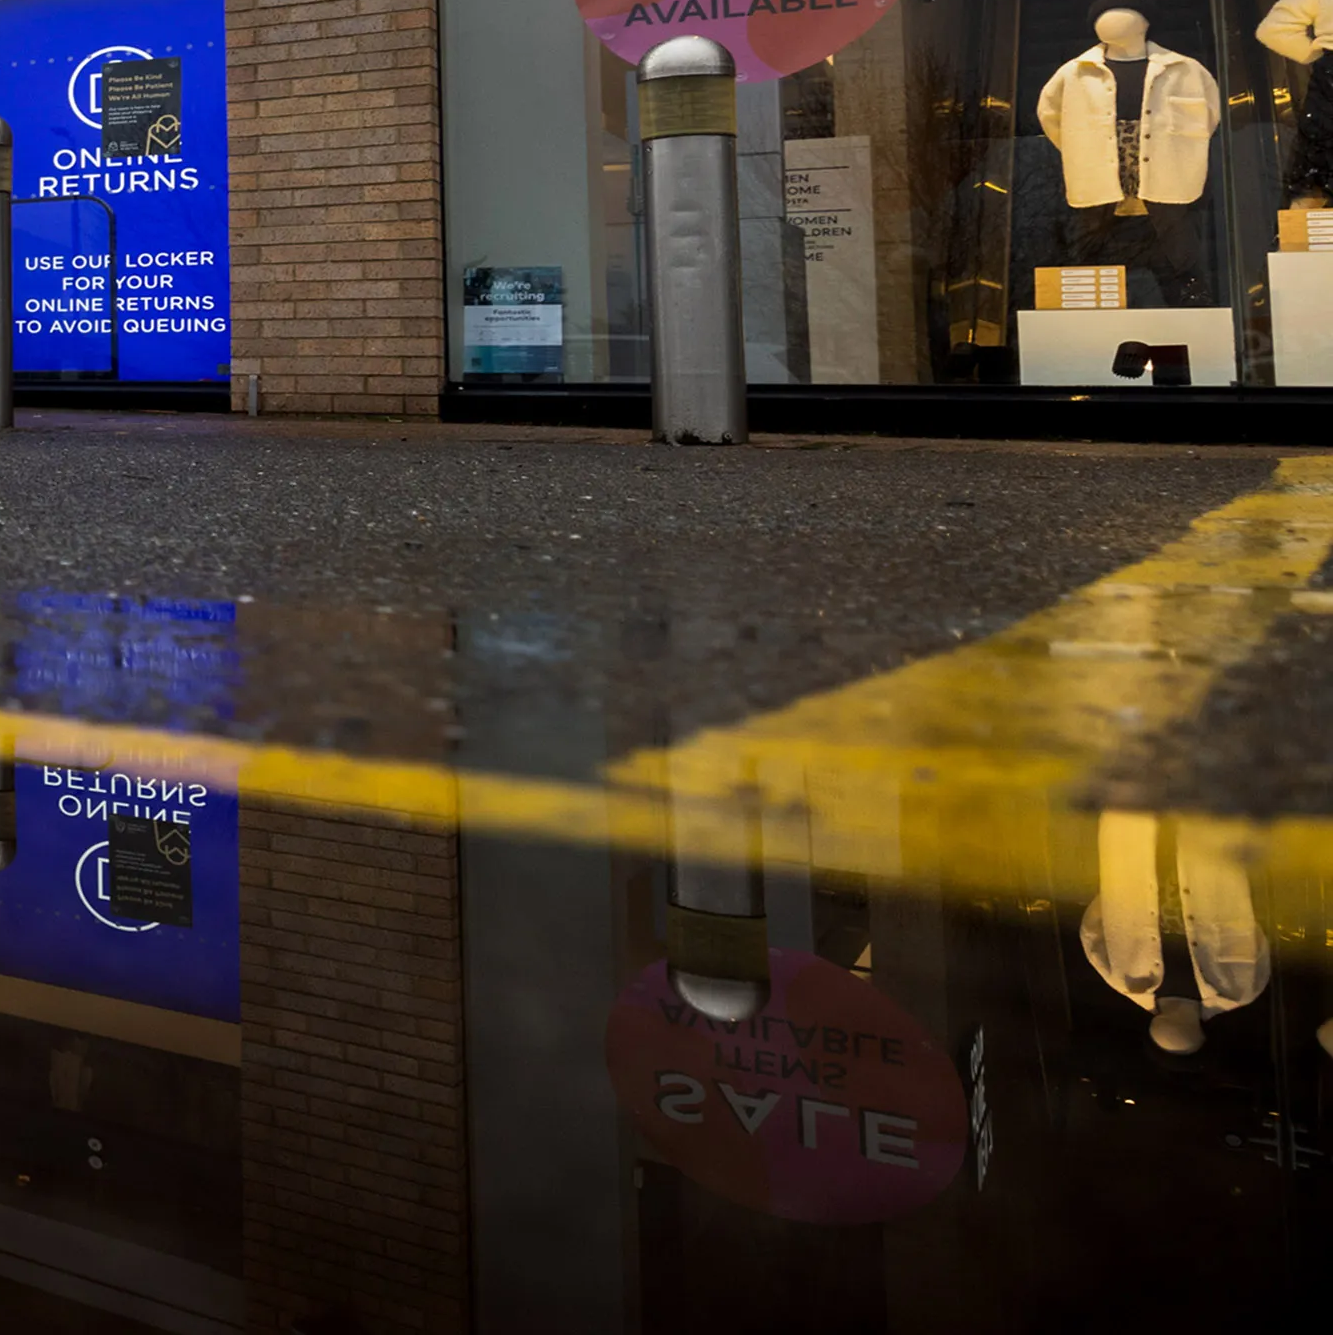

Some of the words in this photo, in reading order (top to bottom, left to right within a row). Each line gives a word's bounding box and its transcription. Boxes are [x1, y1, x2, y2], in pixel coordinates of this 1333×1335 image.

[108, 76, 132, 84] Please
[134, 74, 144, 82] Be
[145, 73, 163, 81] Kind
[108, 85, 133, 93] Please
[134, 83, 144, 91] Be
[145, 82, 174, 90] Patient
[39, 167, 199, 197] RETURNS
[784, 174, 810, 184] EN
[786, 185, 821, 195] OME
[25, 256, 64, 270] USE
[126, 251, 214, 267] LOCKER
[62, 276, 105, 290] FOR
[116, 274, 173, 289] YOUR
[493, 281, 532, 290] We're
[480, 291, 546, 302] recruiting
[25, 298, 103, 312] ONLINE
[116, 295, 215, 311] RETURNS
[484, 315, 541, 323] opportunities
[15, 320, 42, 333] TO
[49, 319, 112, 333] AVOID
[123, 318, 226, 333] QUEUING
